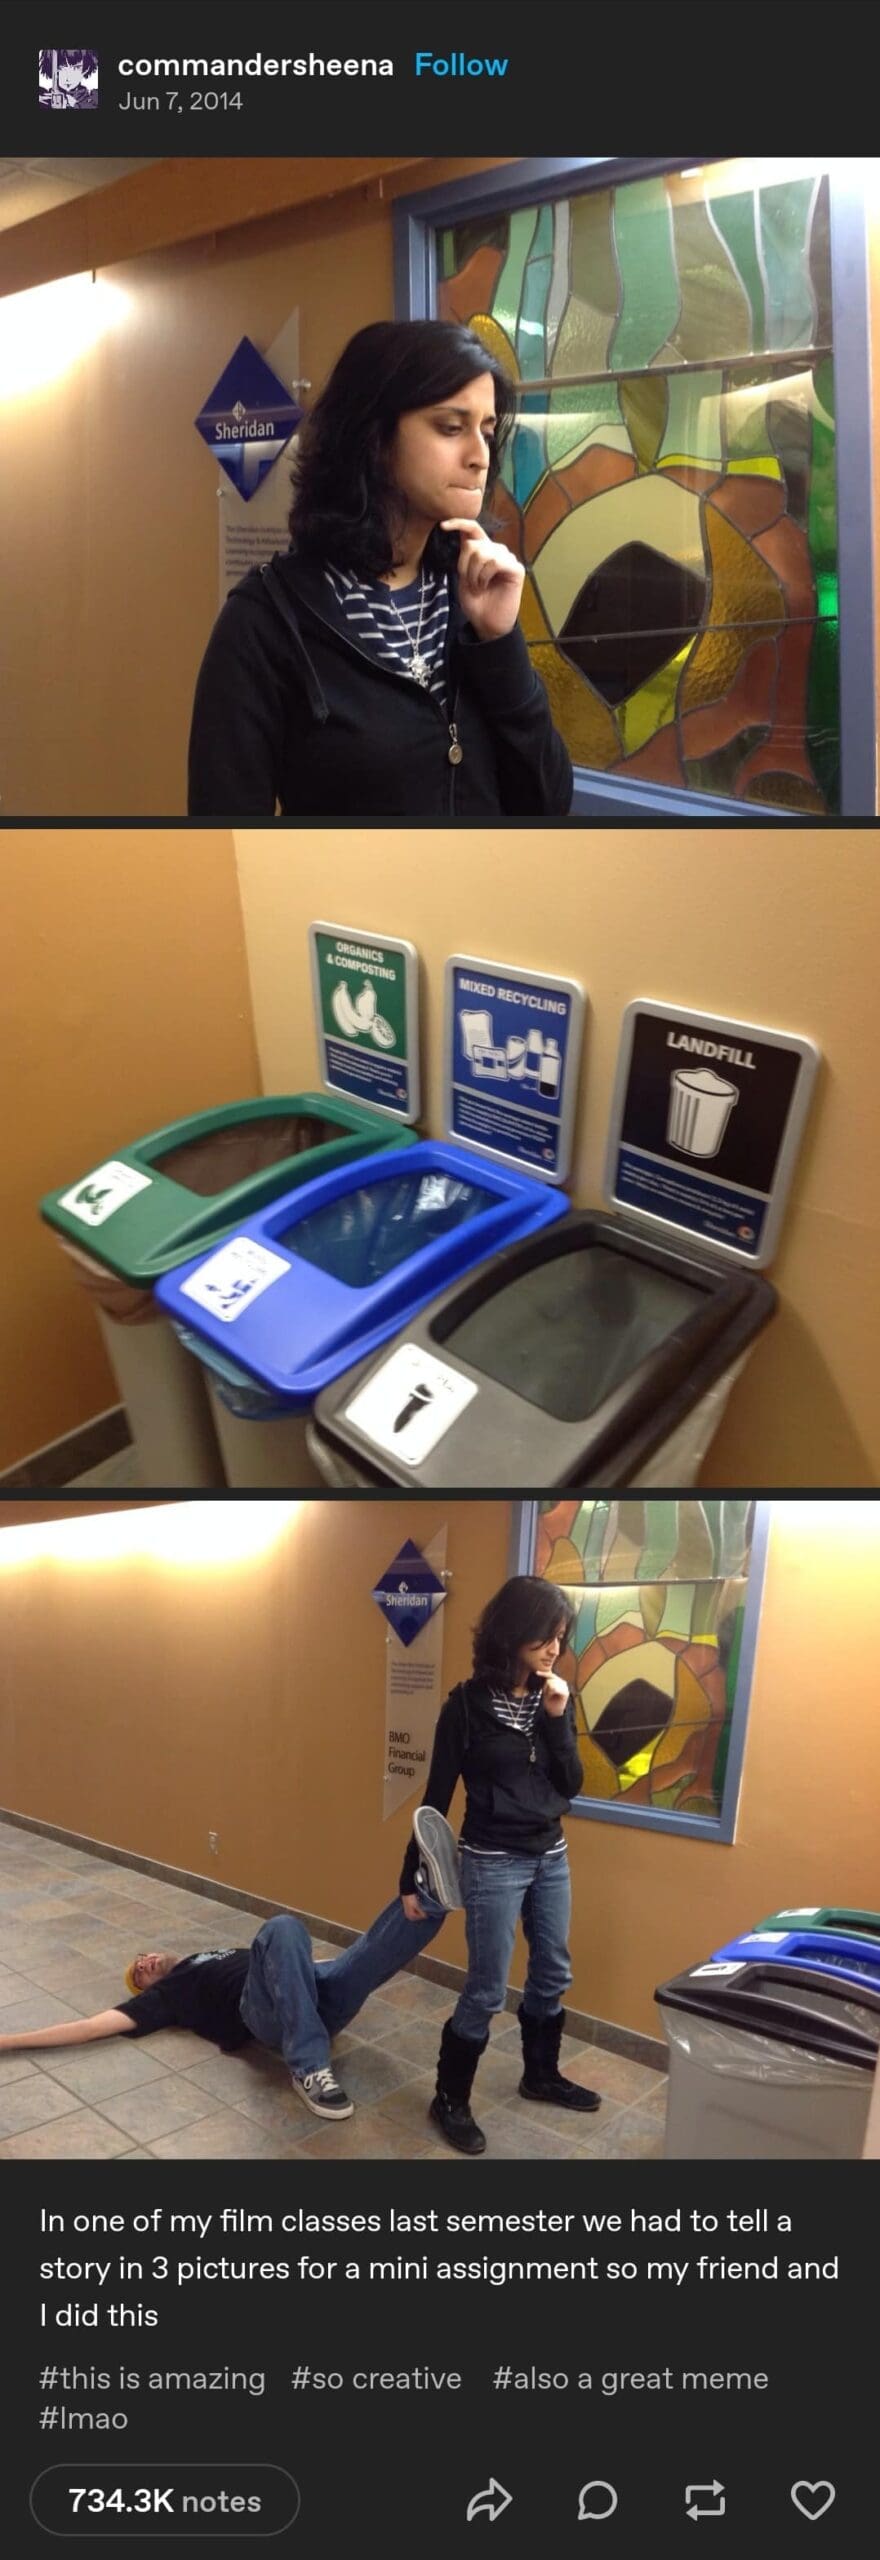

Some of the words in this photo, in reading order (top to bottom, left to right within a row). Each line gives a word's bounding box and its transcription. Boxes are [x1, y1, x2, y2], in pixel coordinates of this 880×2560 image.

[215, 420, 275, 440] Sheridan
[335, 941, 385, 963] ORGANICS
[326, 953, 334, 965] &
[334, 954, 397, 981] COMPOSTING
[459, 978, 496, 997] MIXED
[497, 987, 567, 1016] RECYCLING
[666, 1031, 757, 1070] LANDFILL
[386, 1594, 428, 1607] Sheridan
[388, 1730, 410, 1744] BMO
[388, 1746, 426, 1762] Financial
[387, 1761, 416, 1779] Group
